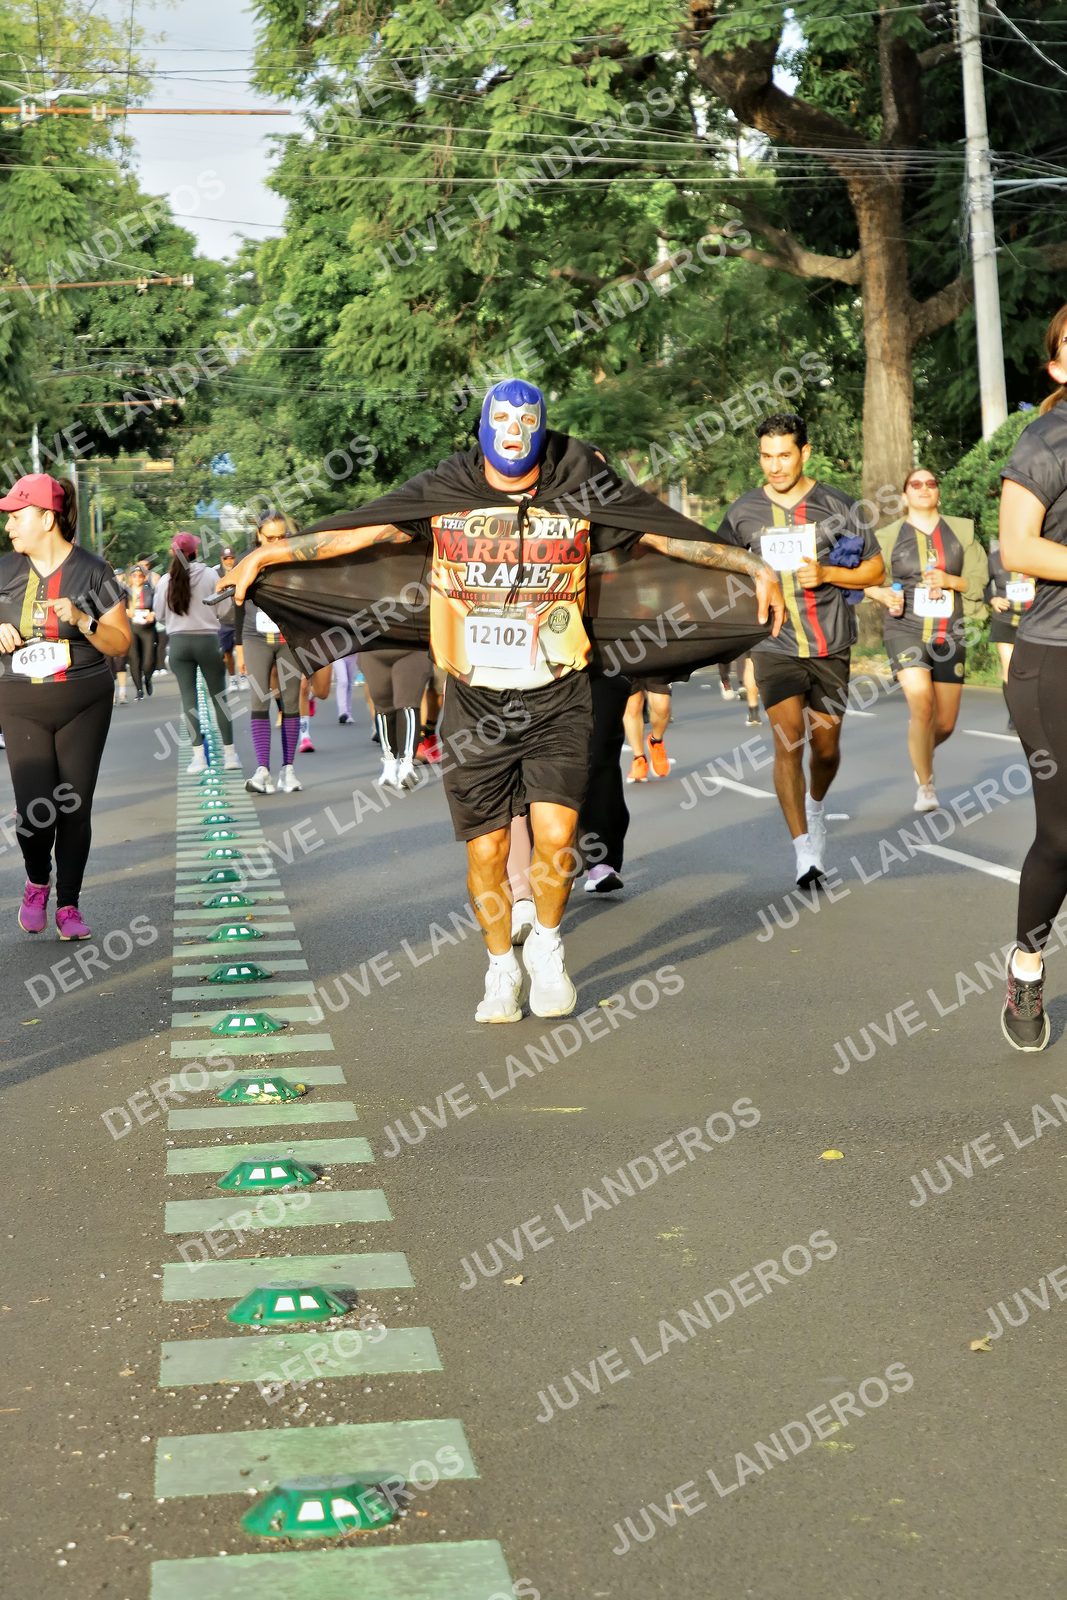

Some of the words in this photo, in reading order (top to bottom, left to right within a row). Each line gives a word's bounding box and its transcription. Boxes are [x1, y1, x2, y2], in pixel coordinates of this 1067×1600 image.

[442, 518, 465, 530] THE
[464, 516, 580, 540] GOLDEN
[434, 529, 590, 564] WARRIORS
[769, 540, 803, 554] 4231
[465, 562, 553, 588] RACE
[470, 624, 528, 647] 12102
[20, 646, 56, 665] 6631
